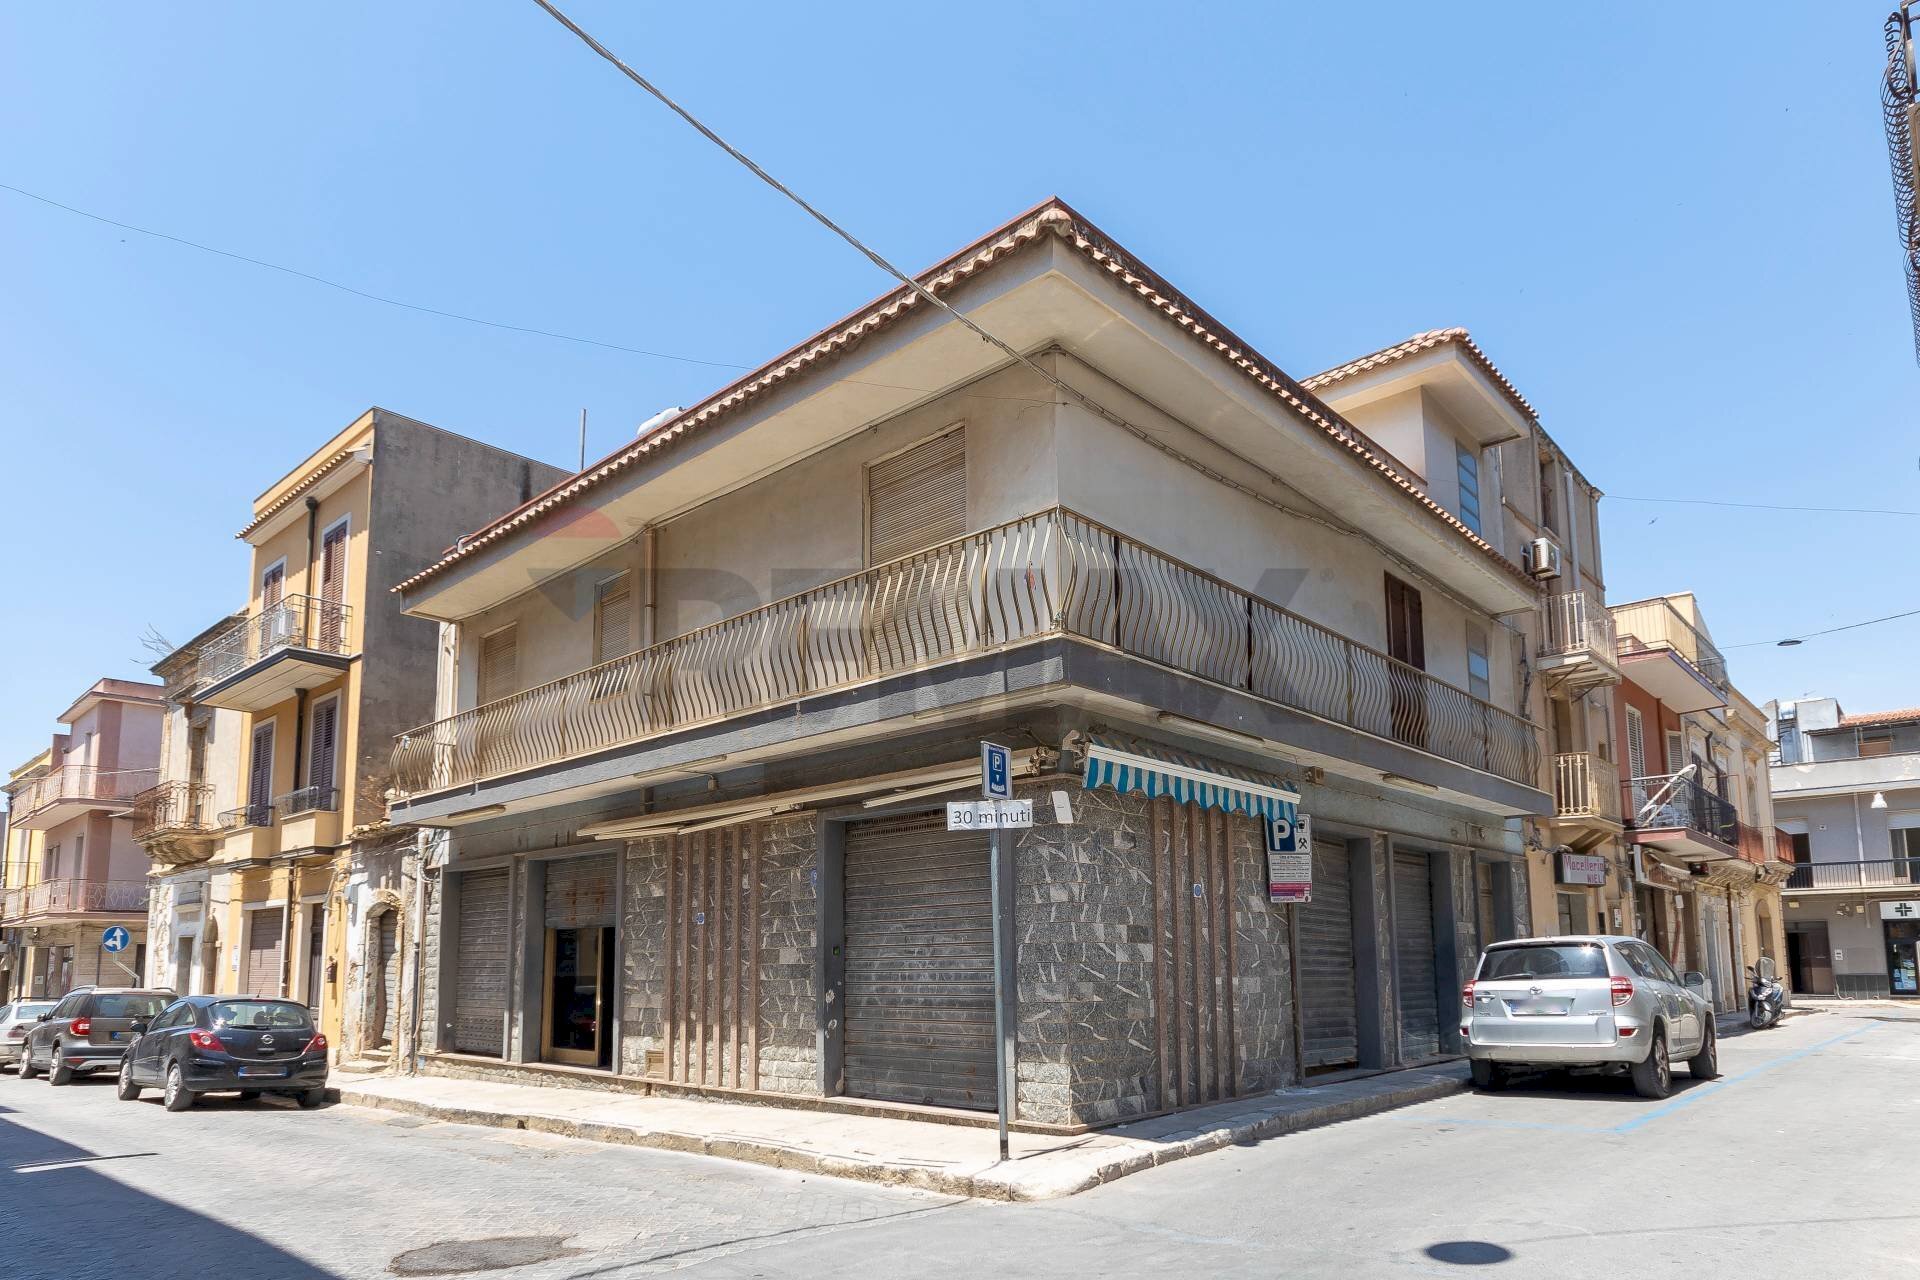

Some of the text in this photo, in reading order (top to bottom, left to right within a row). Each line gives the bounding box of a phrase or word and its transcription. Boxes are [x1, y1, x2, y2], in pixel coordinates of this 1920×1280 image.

[994, 755, 1001, 770] P
[953, 808, 1031, 825] 30 minuti
[1272, 819, 1291, 850] P
